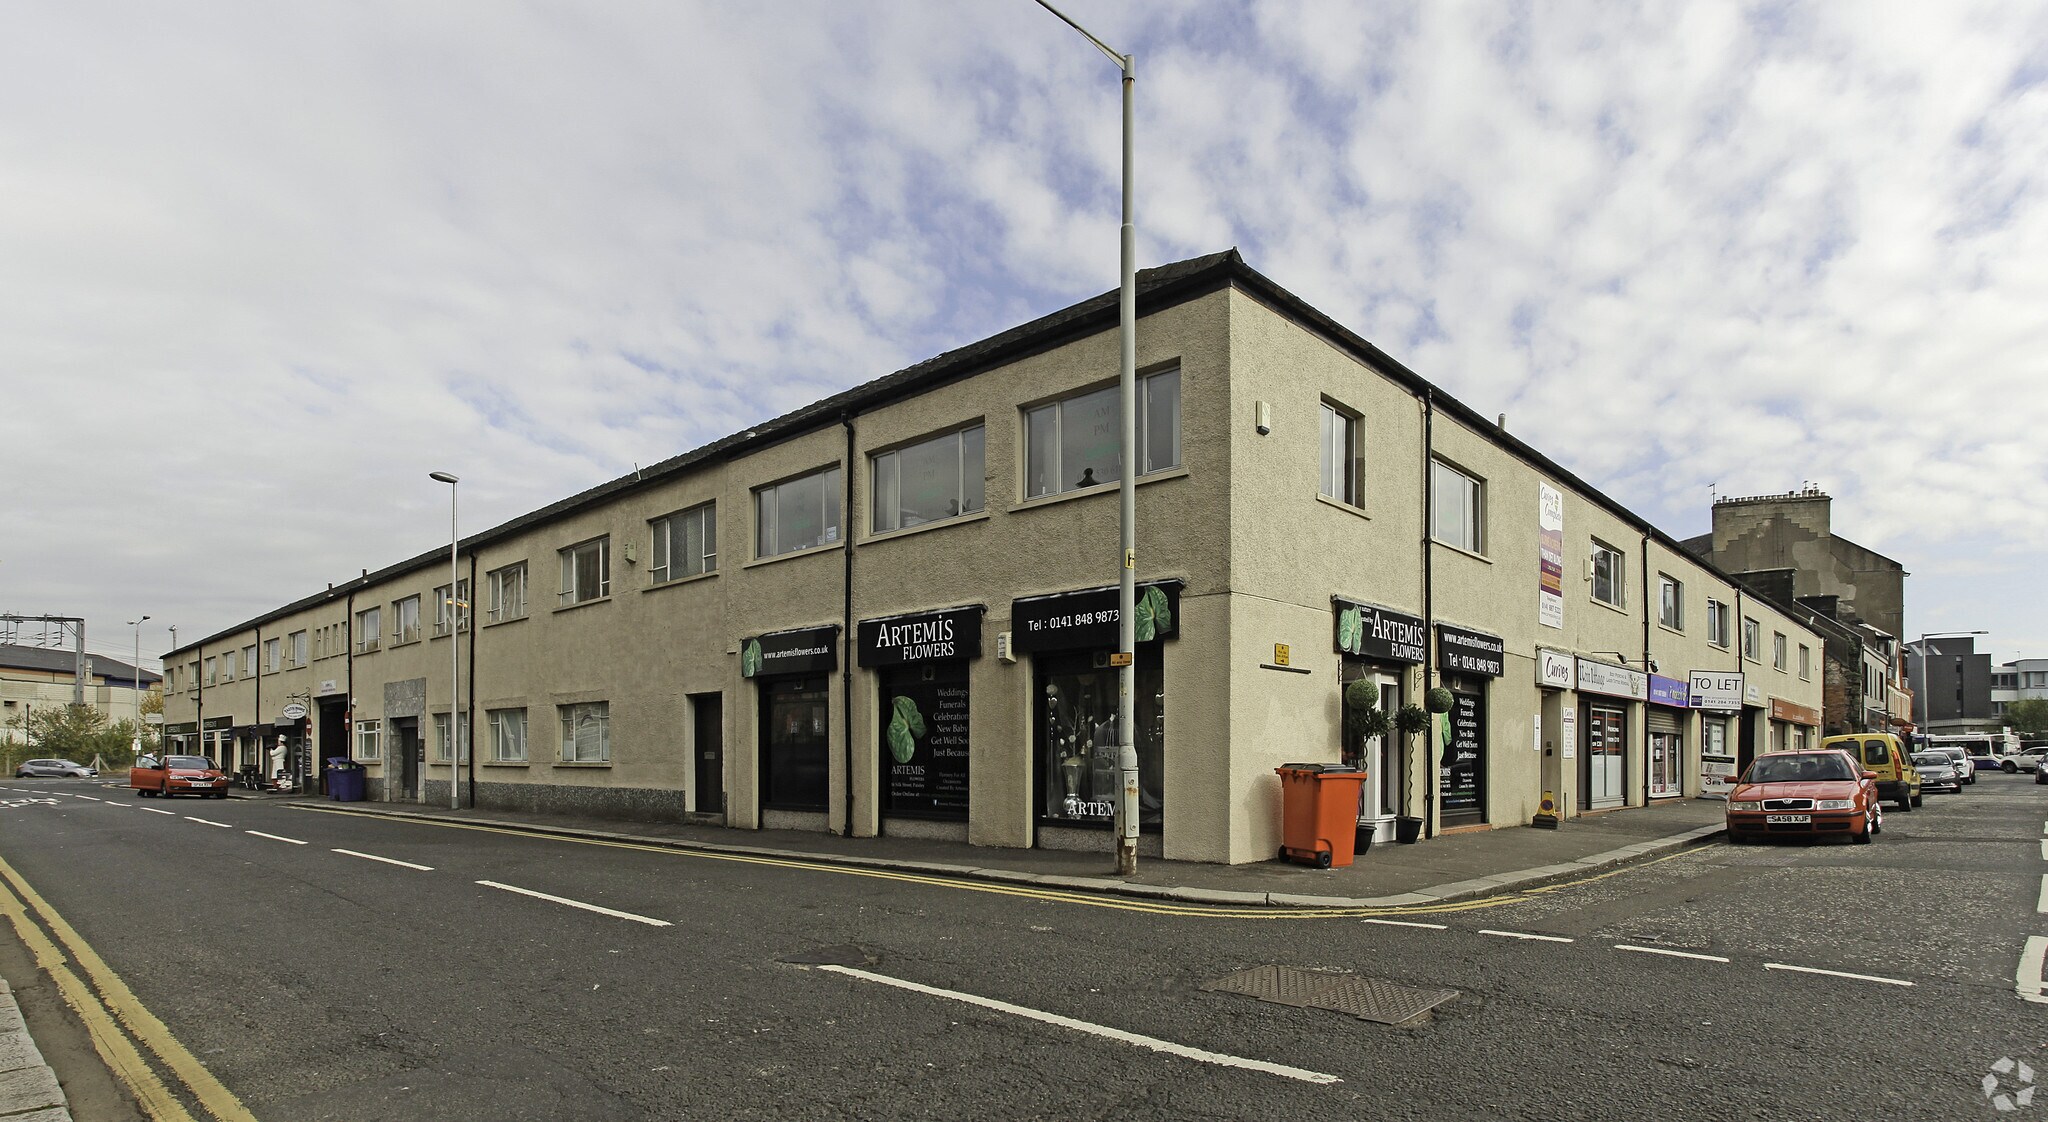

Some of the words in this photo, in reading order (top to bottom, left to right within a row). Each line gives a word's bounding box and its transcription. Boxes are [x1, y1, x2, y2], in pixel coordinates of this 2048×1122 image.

[1028, 620, 1042, 631] Tel
[1050, 615, 1072, 629] 0141
[1075, 612, 1093, 626] 848
[1096, 609, 1120, 623] 9873
[1444, 633, 1502, 653] www.artemisflowers.co.uk
[764, 645, 828, 659] www.artemisflowers.co.uk
[903, 642, 954, 660] FLOWERS
[1391, 643, 1424, 661] FLOWERS
[1448, 653, 1458, 667] Tel
[1462, 656, 1476, 670] 0141
[1476, 658, 1486, 672] 848
[1487, 660, 1500, 674] 9873
[1693, 678, 1711, 689] TO
[1717, 679, 1741, 690] LET
[937, 688, 968, 698] Weddings
[939, 700, 966, 709] Funerals
[1459, 698, 1475, 708] Weddings
[933, 712, 969, 721] Celebration
[1460, 708, 1474, 717] Funerals
[1457, 719, 1477, 727] Celebrations
[937, 724, 951, 732] New
[953, 724, 968, 735] Baby
[931, 736, 942, 745] Get
[943, 736, 957, 744] Well
[934, 749, 945, 758] Just
[891, 765, 925, 775] ARTEMIS
[1067, 802, 1115, 816] ARTEM
